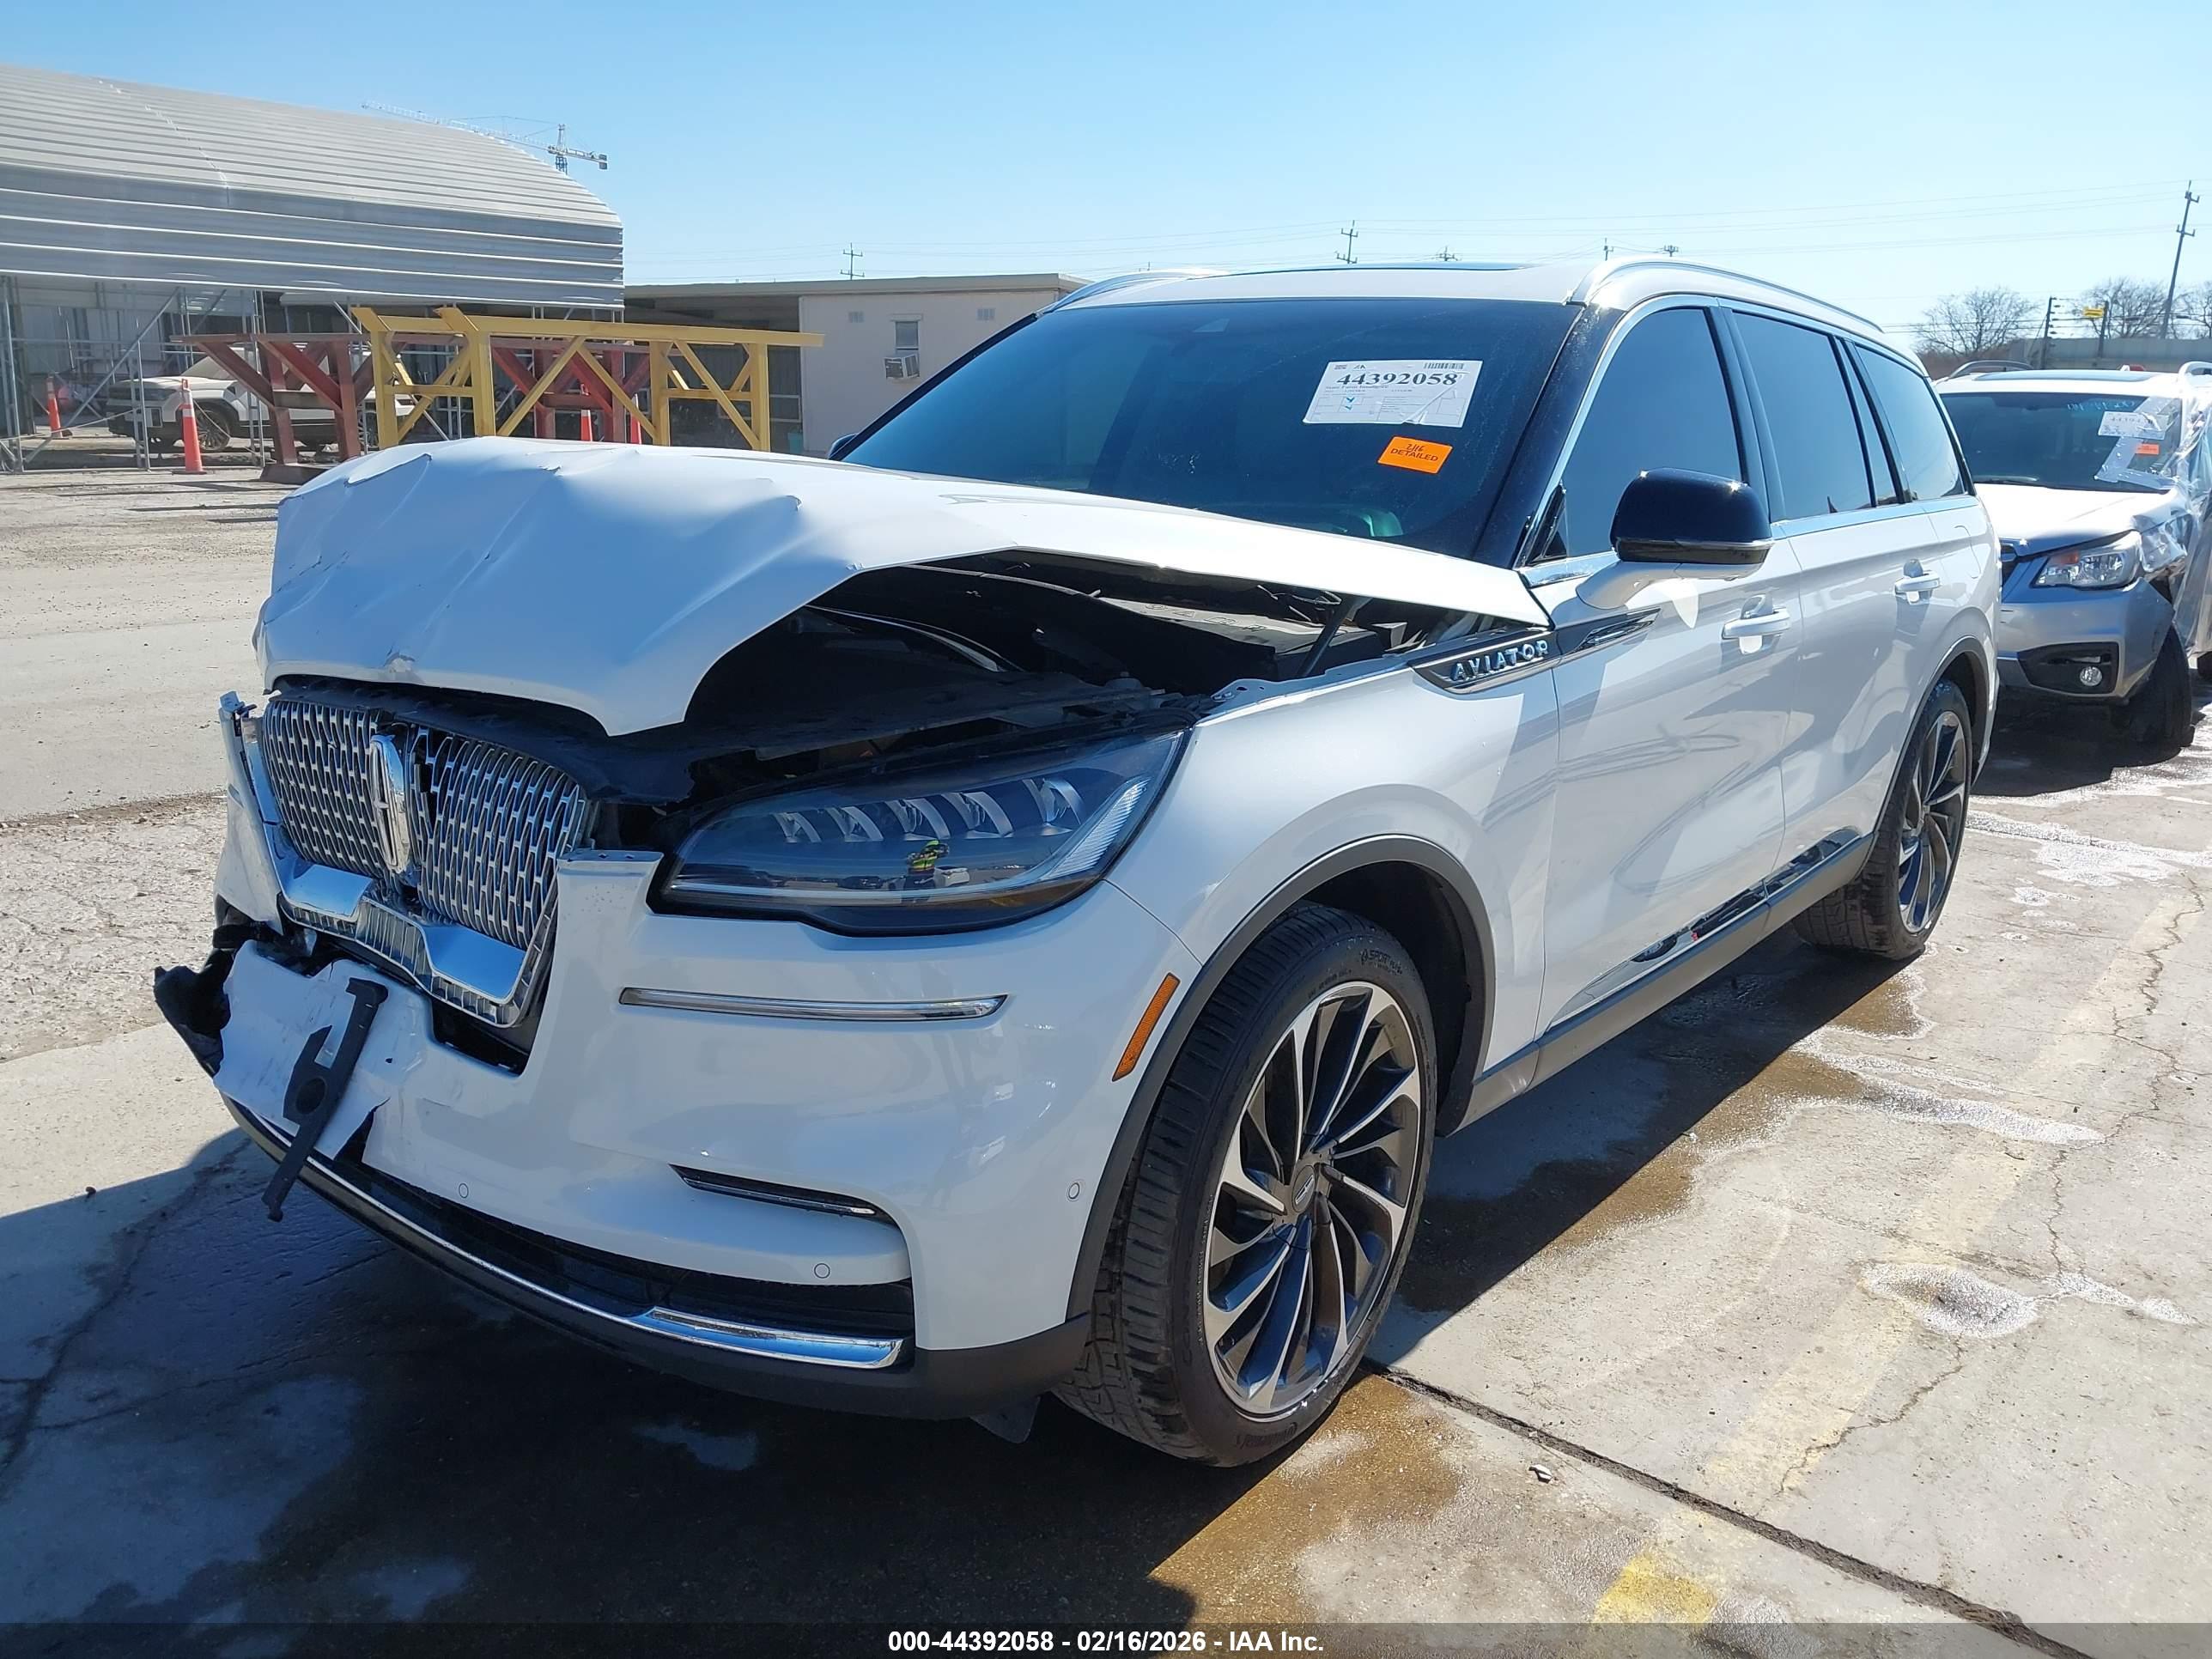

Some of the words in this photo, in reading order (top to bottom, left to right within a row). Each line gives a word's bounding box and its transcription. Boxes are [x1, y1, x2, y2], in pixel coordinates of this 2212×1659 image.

[1337, 373, 1456, 385] 44392058
[1390, 448, 1438, 461] DETAILED
[1453, 641, 1549, 681] AVIATOR
